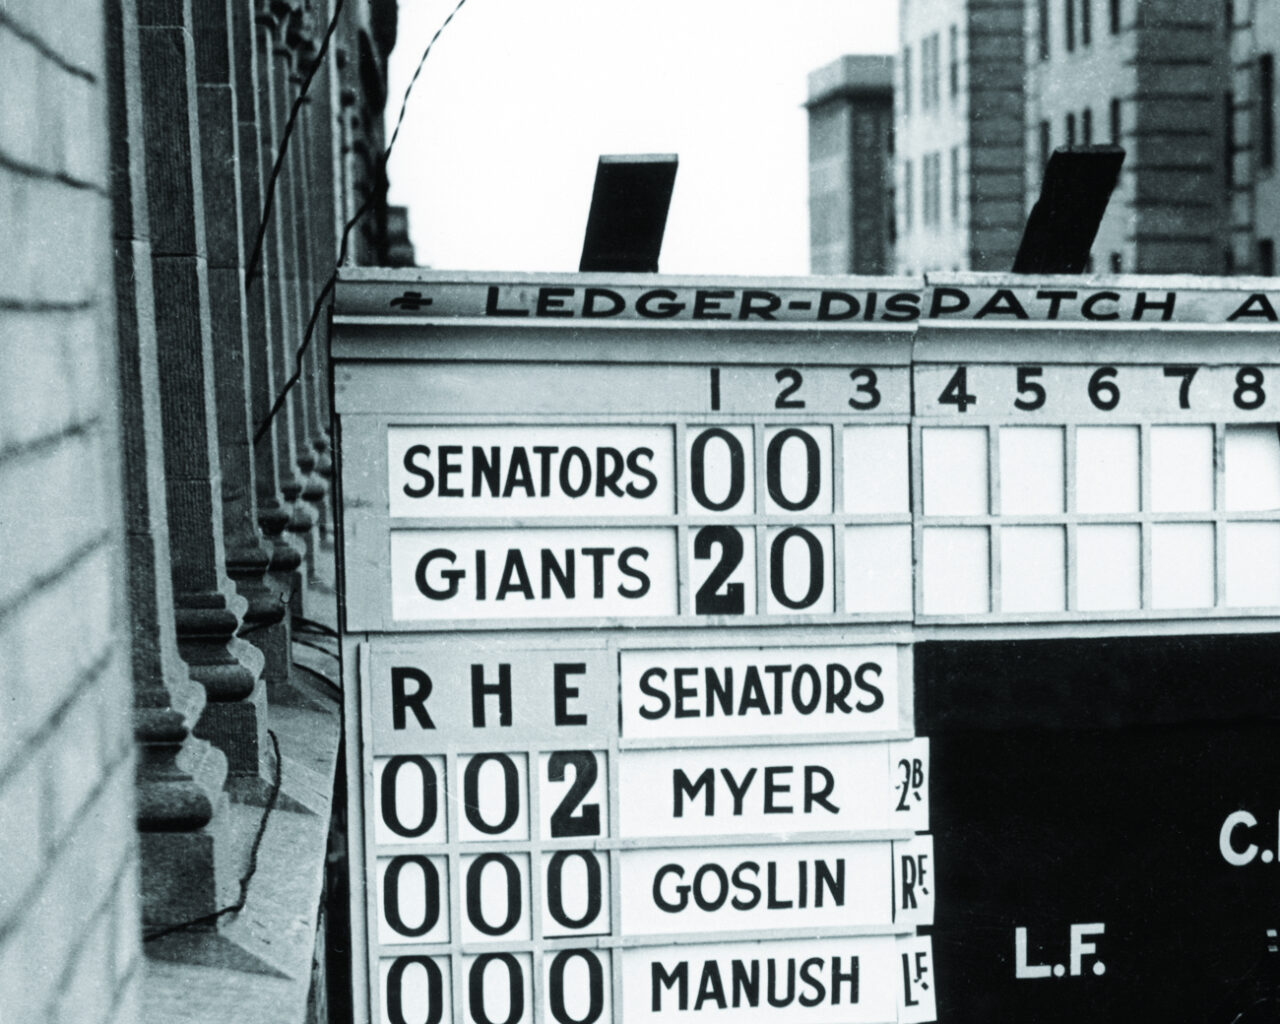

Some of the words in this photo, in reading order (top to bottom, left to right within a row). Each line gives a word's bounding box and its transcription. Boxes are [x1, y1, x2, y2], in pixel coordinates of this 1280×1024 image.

[484, 286, 1176, 322] LEDGER-DISPATCH
[709, 368, 720, 411] 1
[775, 368, 804, 409] 2
[848, 368, 880, 410] 3
[938, 367, 976, 412] 4
[1014, 368, 1046, 410] 5
[1088, 368, 1120, 410] 6
[1164, 368, 1197, 408] 7
[1234, 367, 1266, 410] 8
[403, 445, 657, 499] SENATORS
[691, 428, 745, 511] 0
[767, 428, 820, 511] 0
[415, 547, 650, 600] GIANTS
[695, 525, 744, 615] 2
[770, 526, 824, 609] 0
[391, 667, 435, 730] R
[471, 664, 512, 727] H
[554, 663, 587, 726] E
[639, 662, 884, 720] SENATORS
[380, 755, 437, 837] 0
[464, 752, 519, 834] 0
[548, 750, 600, 837] 2
[673, 766, 839, 817] MYER
[384, 855, 439, 937] 0
[467, 853, 521, 935] 0
[548, 849, 601, 928] 0
[653, 859, 845, 913] GOSLIN
[652, 956, 859, 1012] MANUSH
[1016, 923, 1105, 978] L.F.
